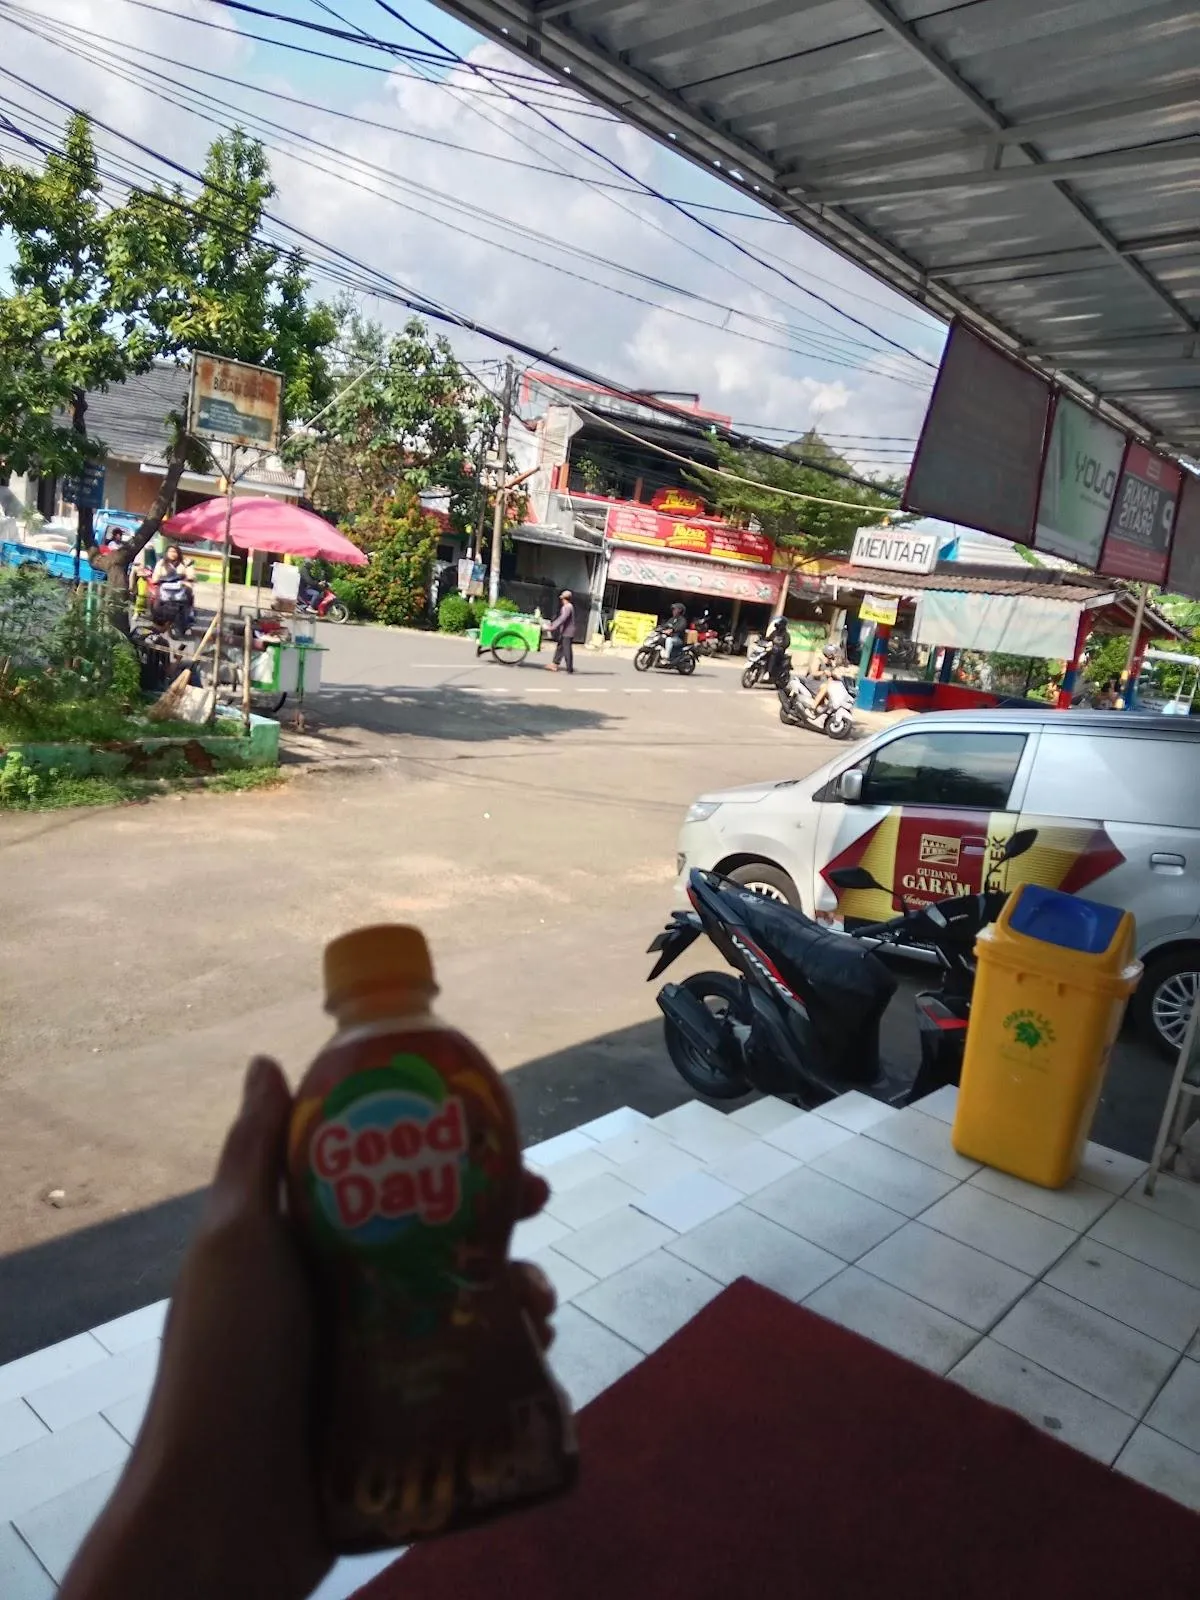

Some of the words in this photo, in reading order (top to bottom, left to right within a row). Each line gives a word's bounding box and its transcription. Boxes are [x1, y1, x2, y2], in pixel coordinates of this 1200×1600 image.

[856, 536, 932, 564] MENTARI
[902, 874, 971, 897] GARAM
[917, 867, 958, 881] GUDANG
[314, 1100, 466, 1179] Good
[335, 1162, 458, 1229] Day
